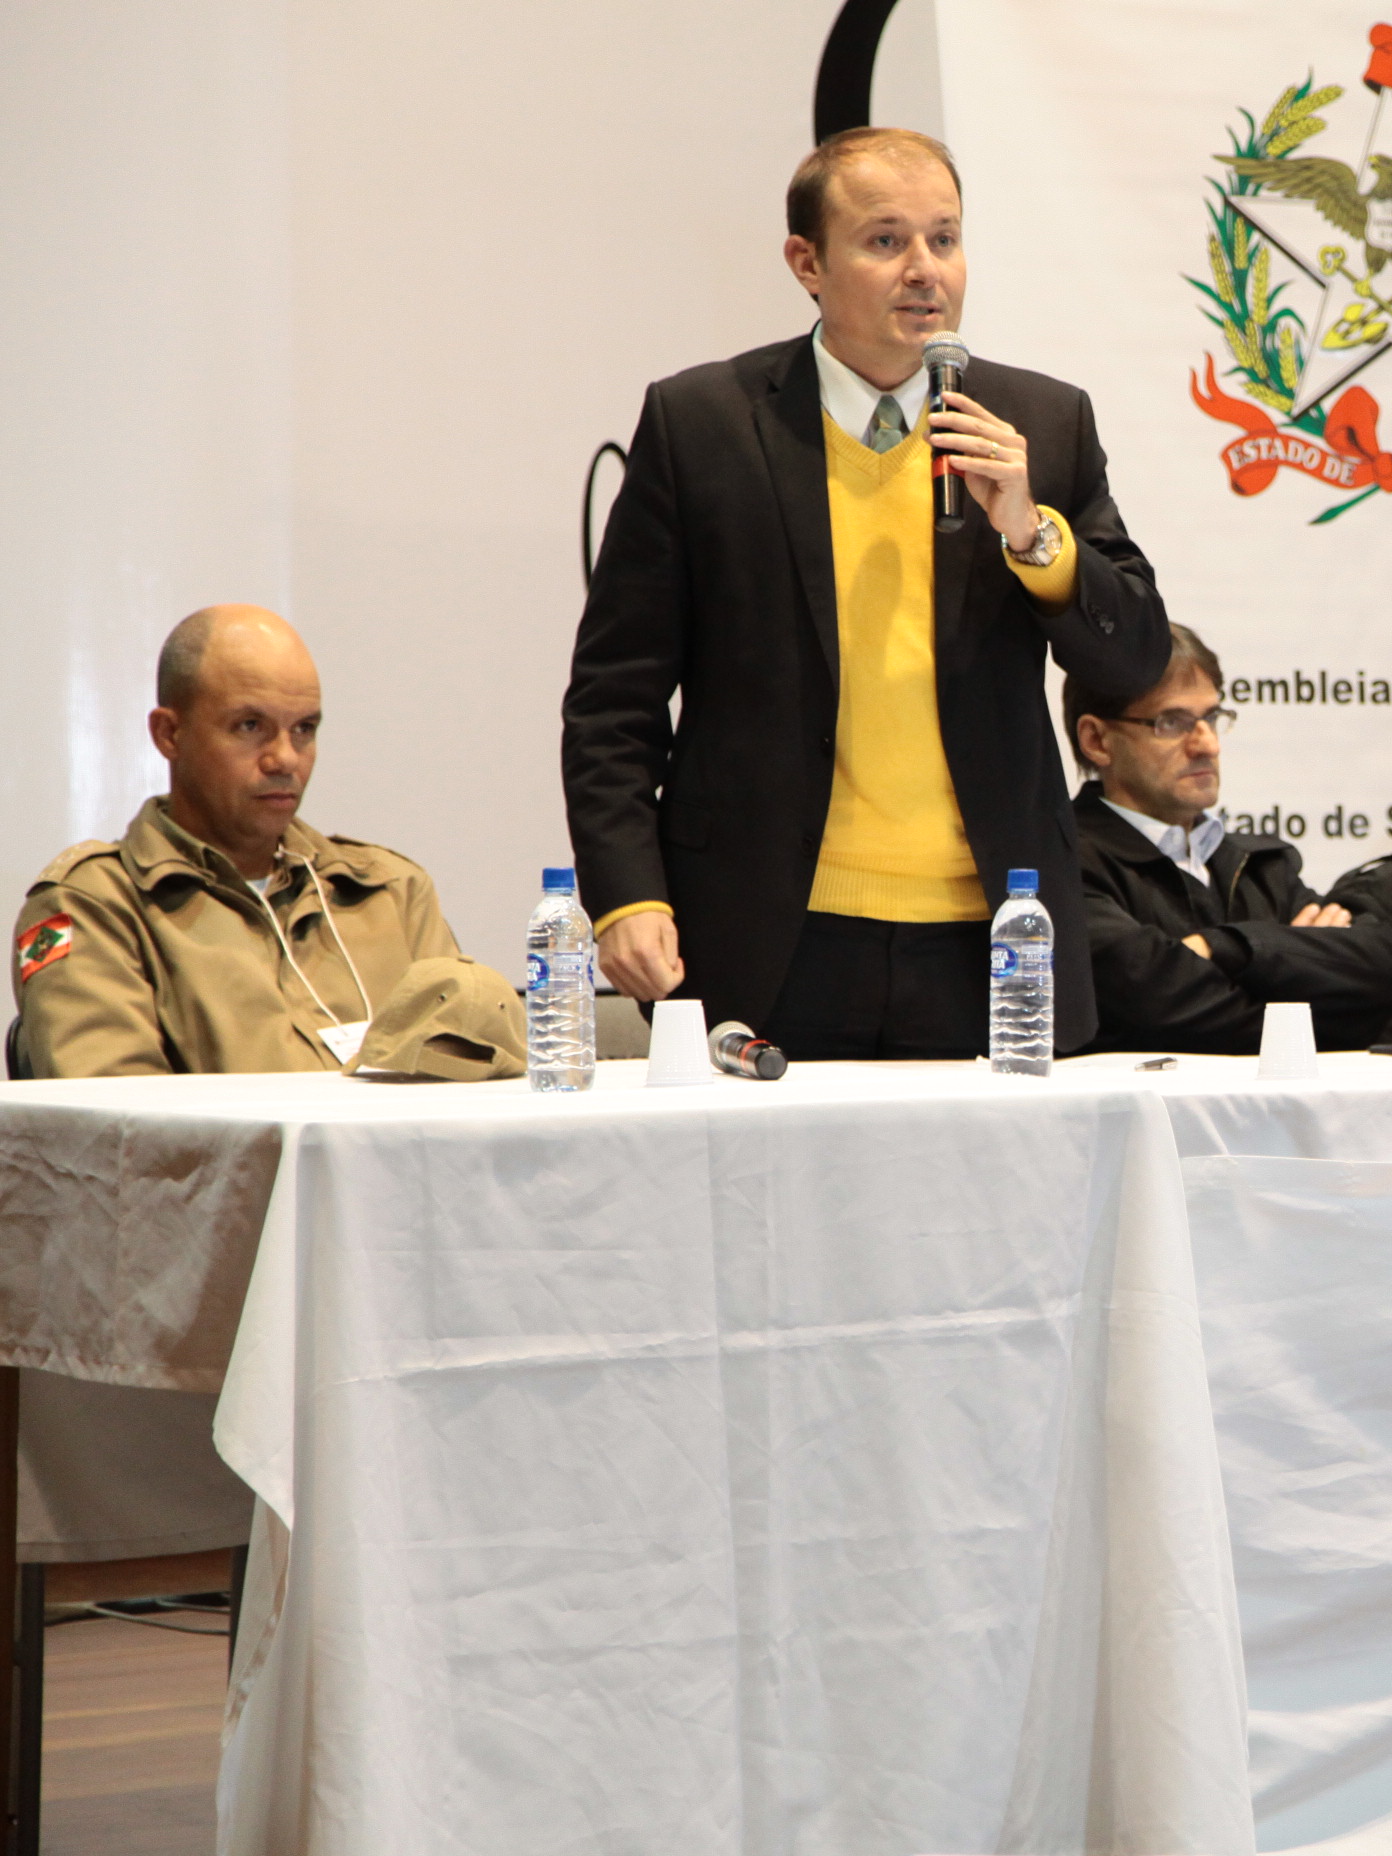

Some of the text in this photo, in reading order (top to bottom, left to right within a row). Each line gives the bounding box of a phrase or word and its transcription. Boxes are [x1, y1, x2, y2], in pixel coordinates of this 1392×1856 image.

[1227, 437, 1322, 470] ESTADO
[1322, 455, 1357, 486] DE
[1323, 804, 1370, 839] de
